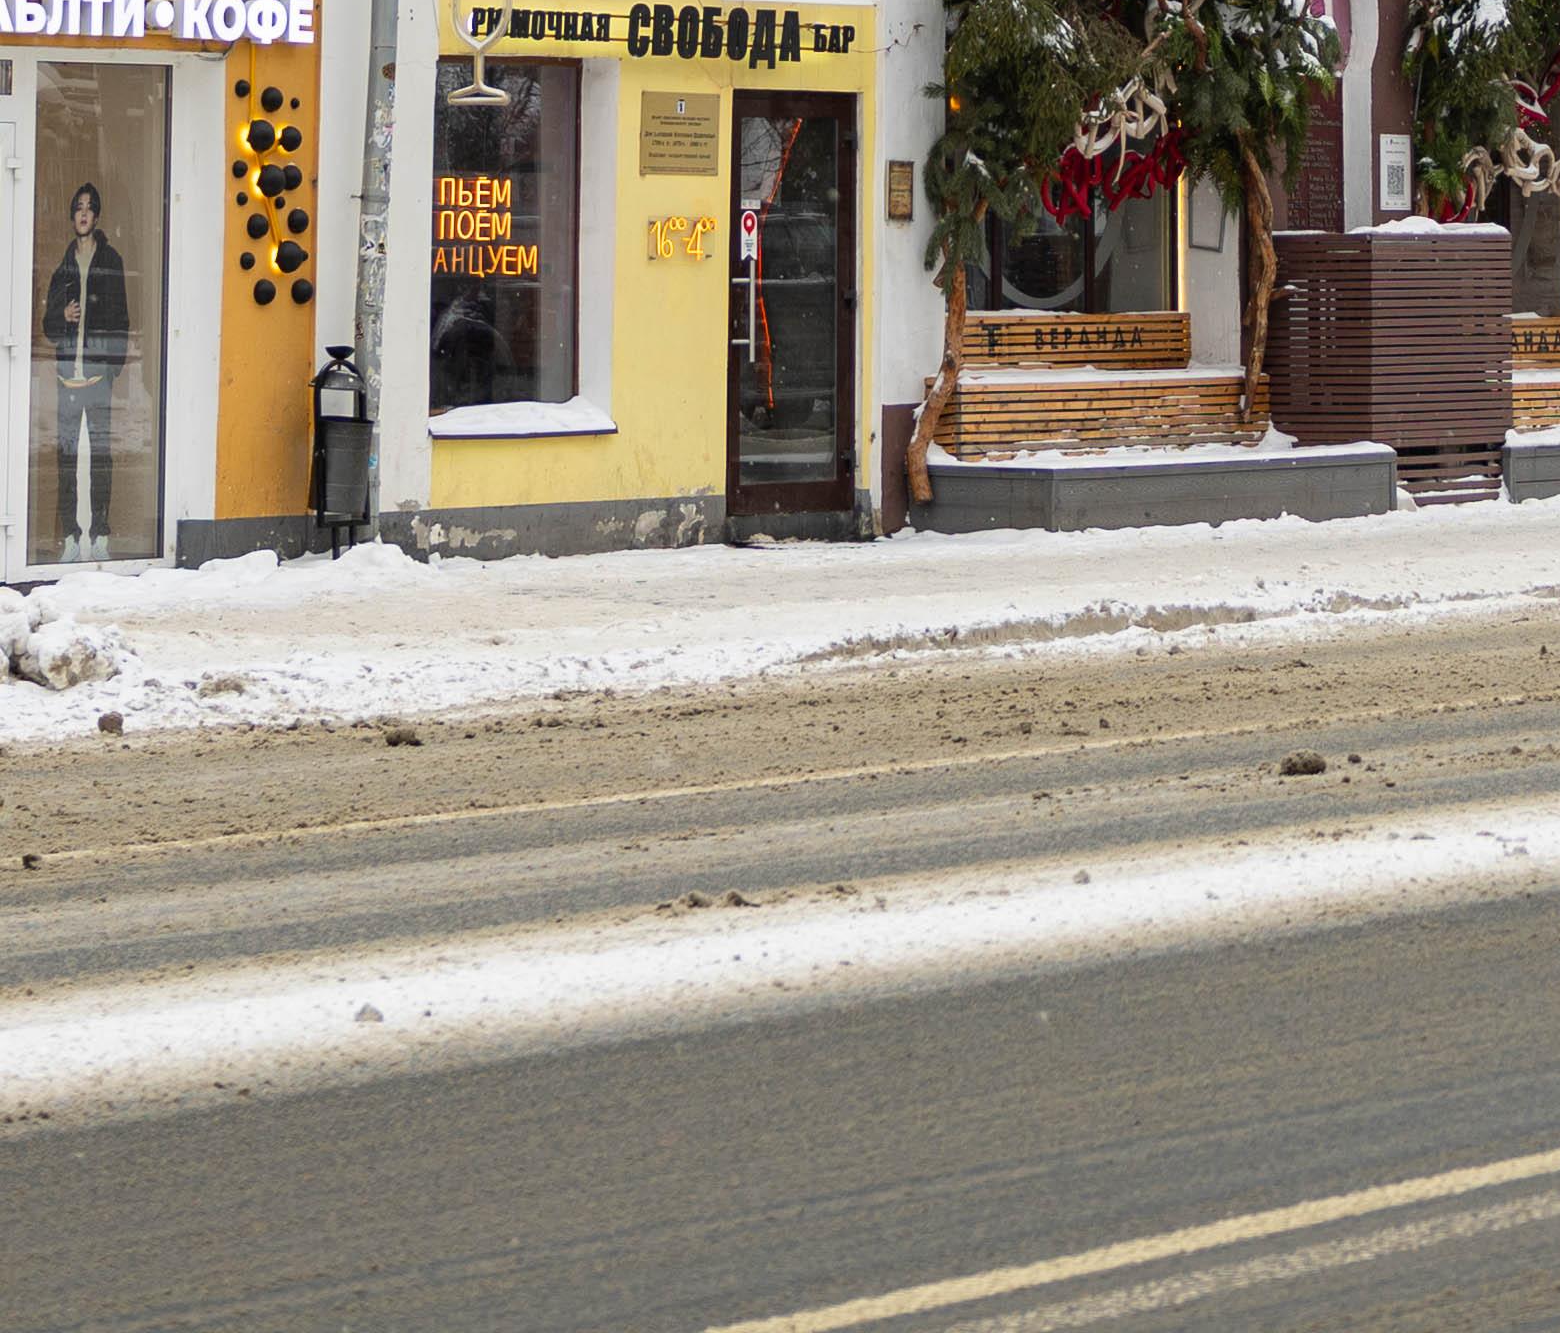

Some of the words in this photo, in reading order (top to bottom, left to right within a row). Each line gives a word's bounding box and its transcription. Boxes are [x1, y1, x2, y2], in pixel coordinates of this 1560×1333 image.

[627, 3, 801, 70] СВОБОДА
[814, 24, 855, 54] БАР
[438, 176, 512, 209] ПЬЁМ
[438, 209, 512, 241] ПОЁМ
[1034, 326, 1145, 351] ВЕРАНДА
